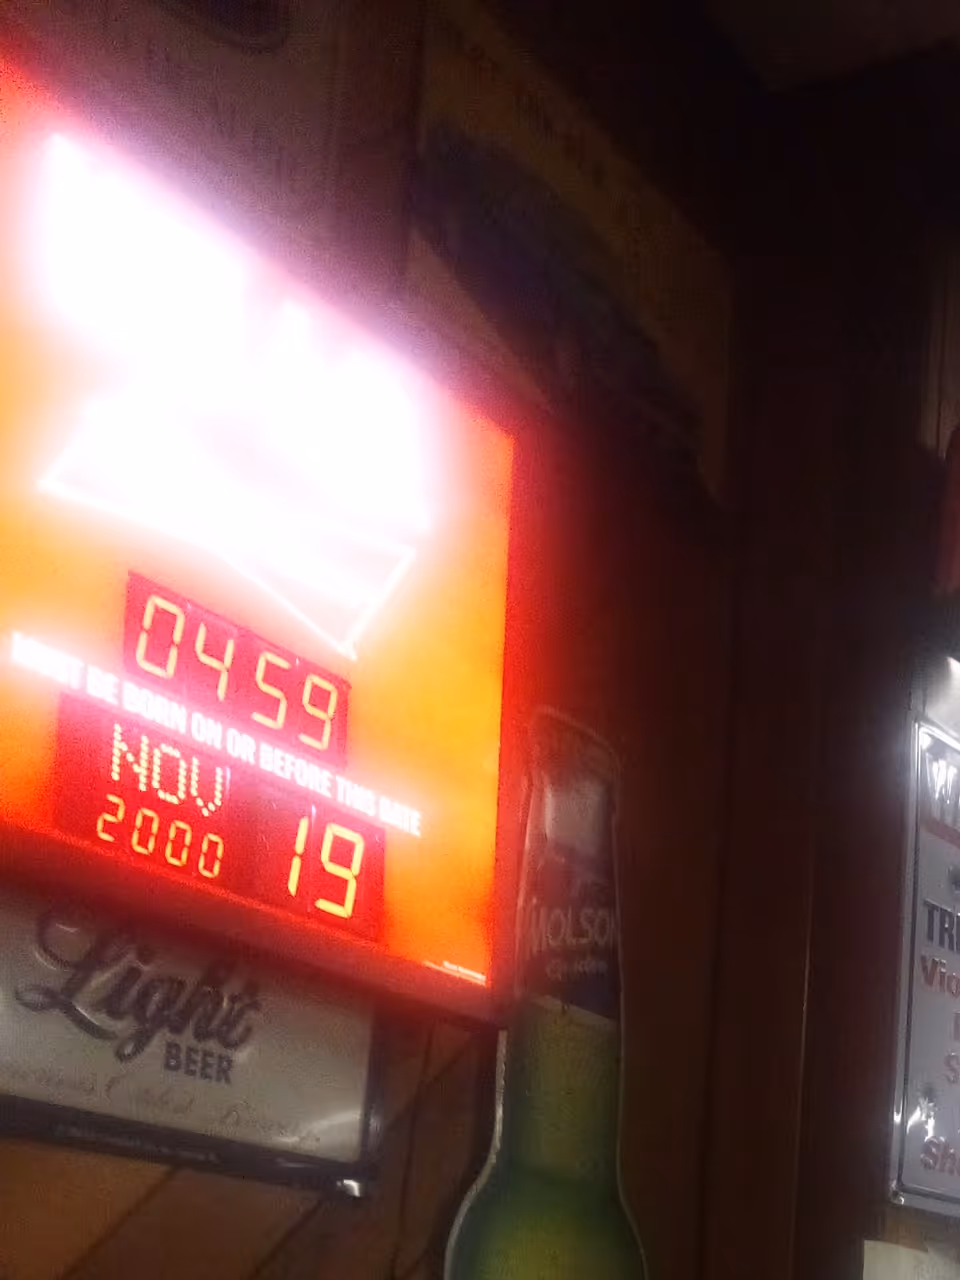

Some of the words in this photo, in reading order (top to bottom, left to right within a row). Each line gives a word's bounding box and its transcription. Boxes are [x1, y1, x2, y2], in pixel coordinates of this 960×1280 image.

[110, 722, 223, 818] NOV
[191, 710, 223, 750] ON
[226, 727, 258, 766] OR
[259, 740, 333, 799] BEFORE
[96, 793, 225, 880] 2000
[286, 814, 365, 920] 19
[15, 903, 262, 1062] Light
[164, 1041, 235, 1086] BEER
